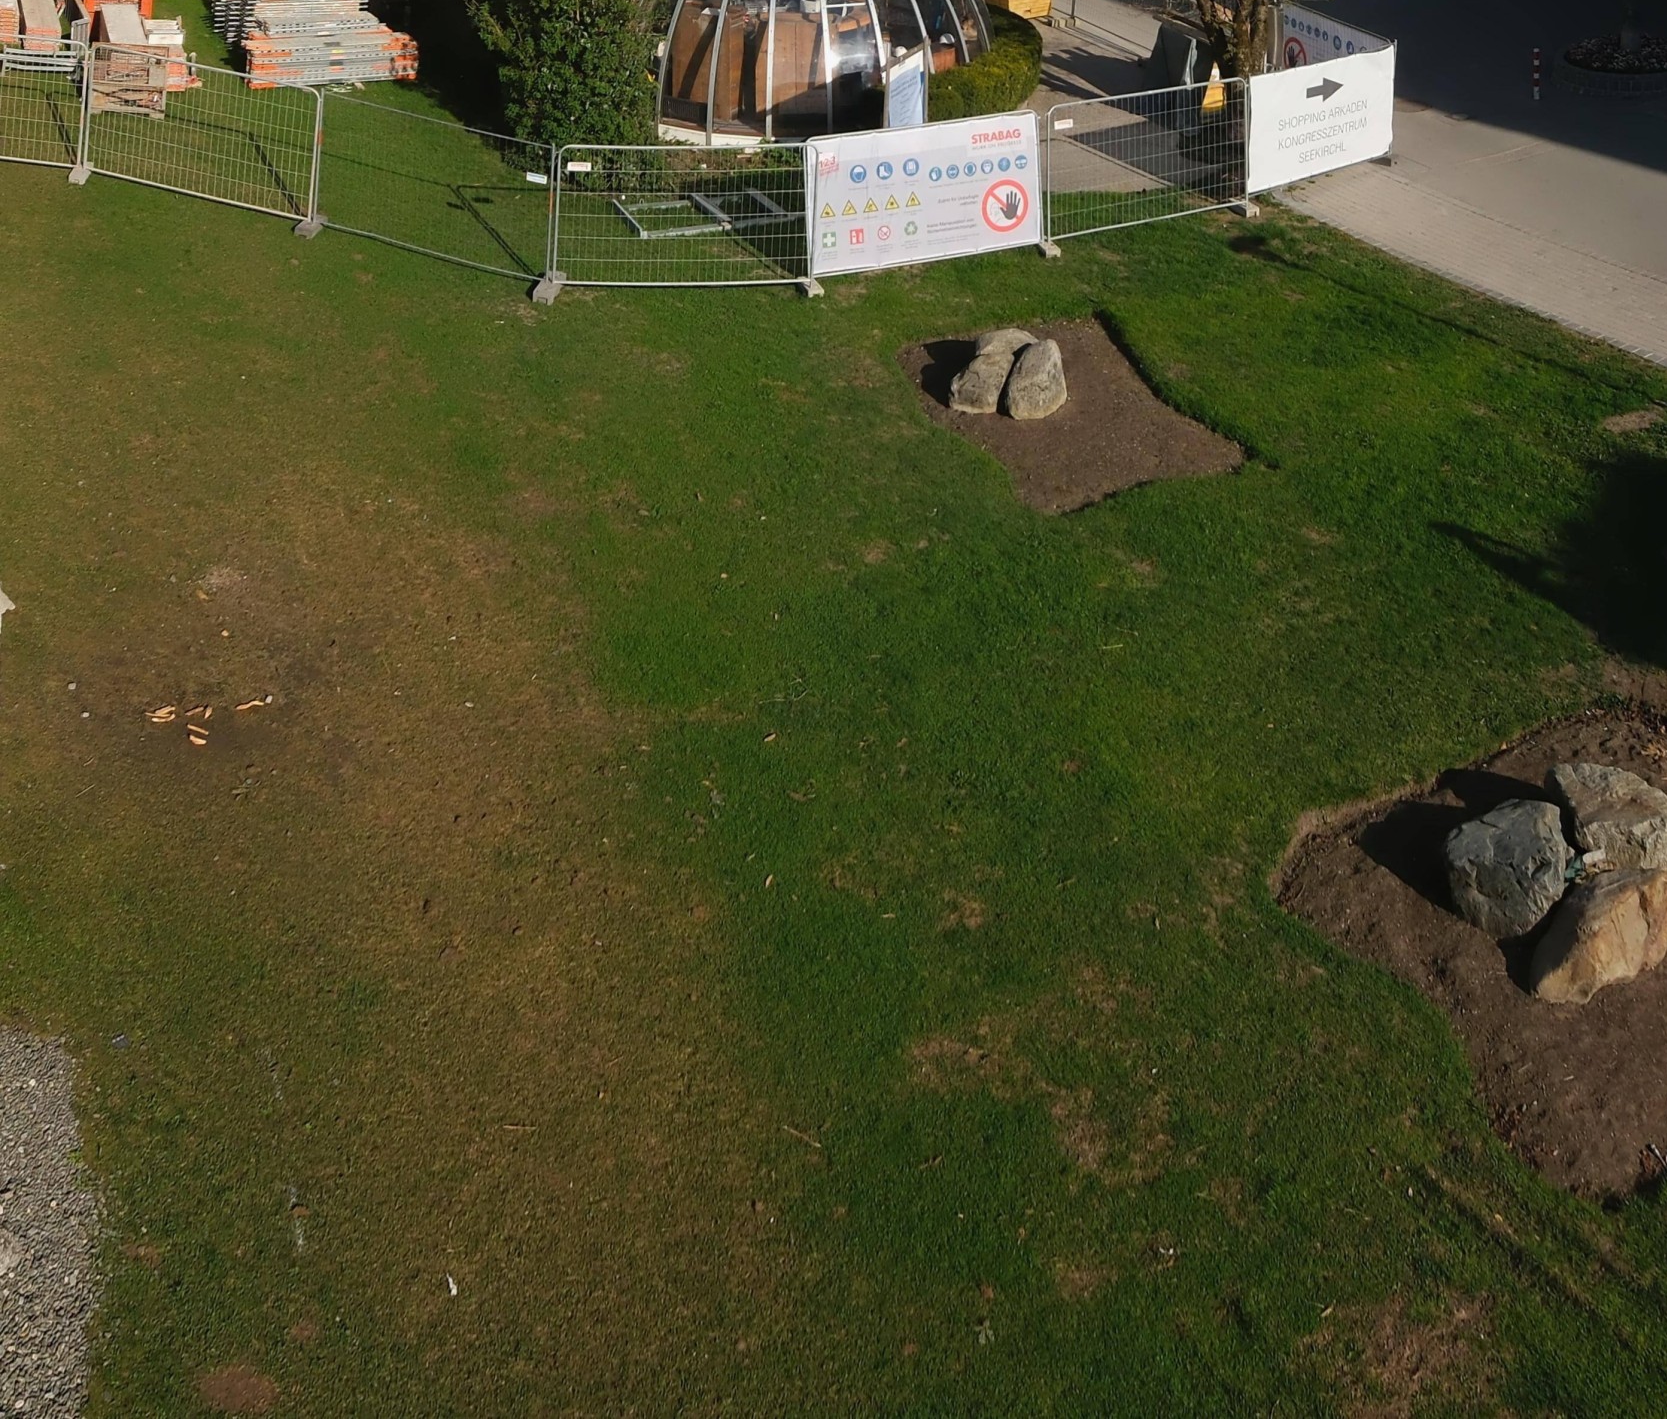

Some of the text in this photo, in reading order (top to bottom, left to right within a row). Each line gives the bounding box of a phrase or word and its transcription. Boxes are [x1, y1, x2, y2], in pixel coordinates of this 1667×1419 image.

[1278, 99, 1368, 131] SHOPPING ARKADEN
[971, 128, 1021, 144] STRABAG
[1278, 117, 1368, 151] KONGRESSZENTRUM
[1298, 141, 1347, 164] SEEKIRCHL
